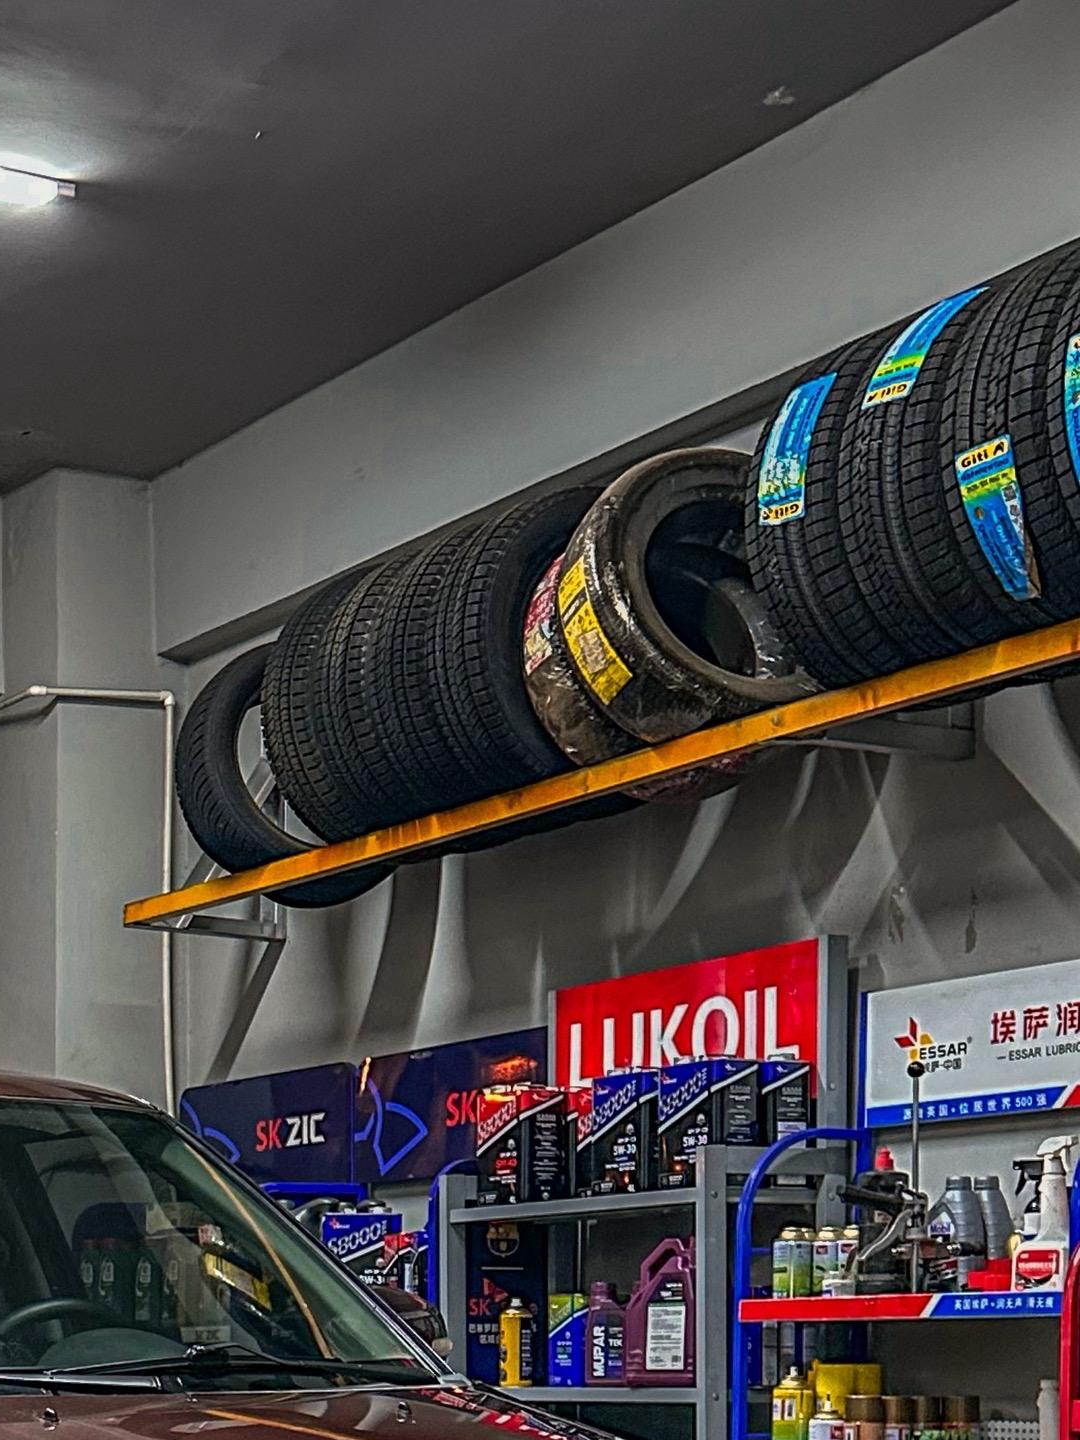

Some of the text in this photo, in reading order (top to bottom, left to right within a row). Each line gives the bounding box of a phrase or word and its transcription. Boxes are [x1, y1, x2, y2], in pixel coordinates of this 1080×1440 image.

[570, 986, 800, 1092] LUKOIL
[990, 1000, 1080, 1045] 埃萨润
[919, 1042, 967, 1060] ESSAR
[1008, 1047, 1041, 1061] ESSAR
[446, 1090, 476, 1128] SK
[255, 1112, 325, 1152] SK ZIC
[592, 1325, 606, 1377] MUPAR
